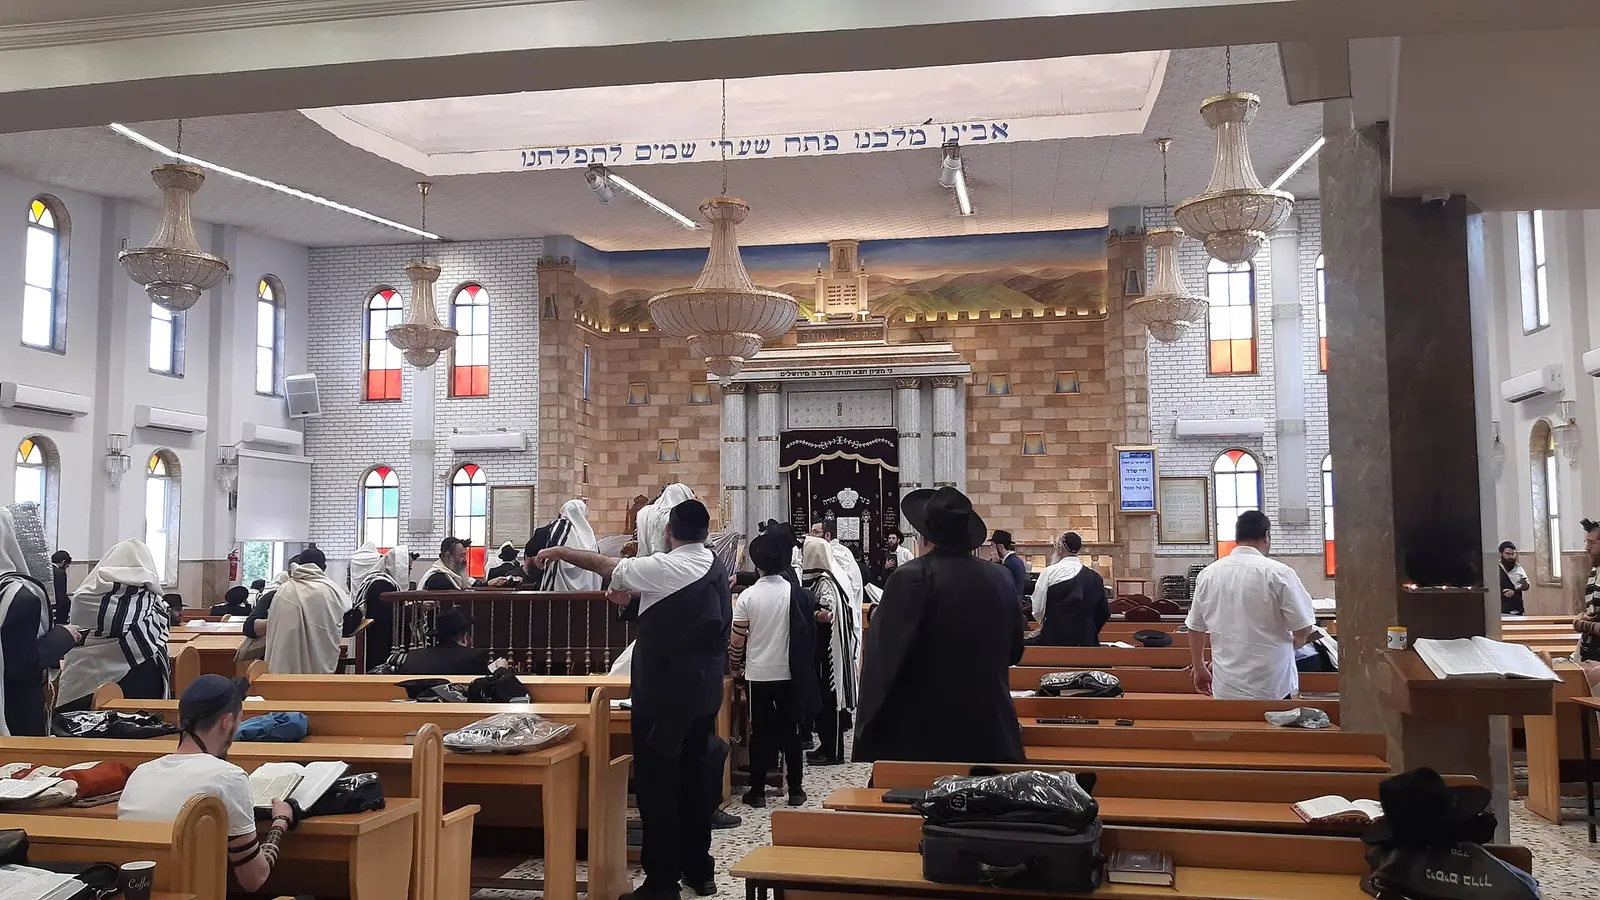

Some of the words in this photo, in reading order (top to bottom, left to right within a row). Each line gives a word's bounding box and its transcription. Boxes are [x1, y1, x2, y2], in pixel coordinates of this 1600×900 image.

[854, 127, 927, 149] מלכנו
[941, 122, 1009, 142] אבינו
[635, 142, 697, 161] שמים
[710, 138, 771, 156] שערי
[784, 134, 839, 152] פתח
[521, 143, 622, 167] לתפלתנו
[1426, 868, 1458, 885] ניסים
[1463, 873, 1493, 887] ברוך
